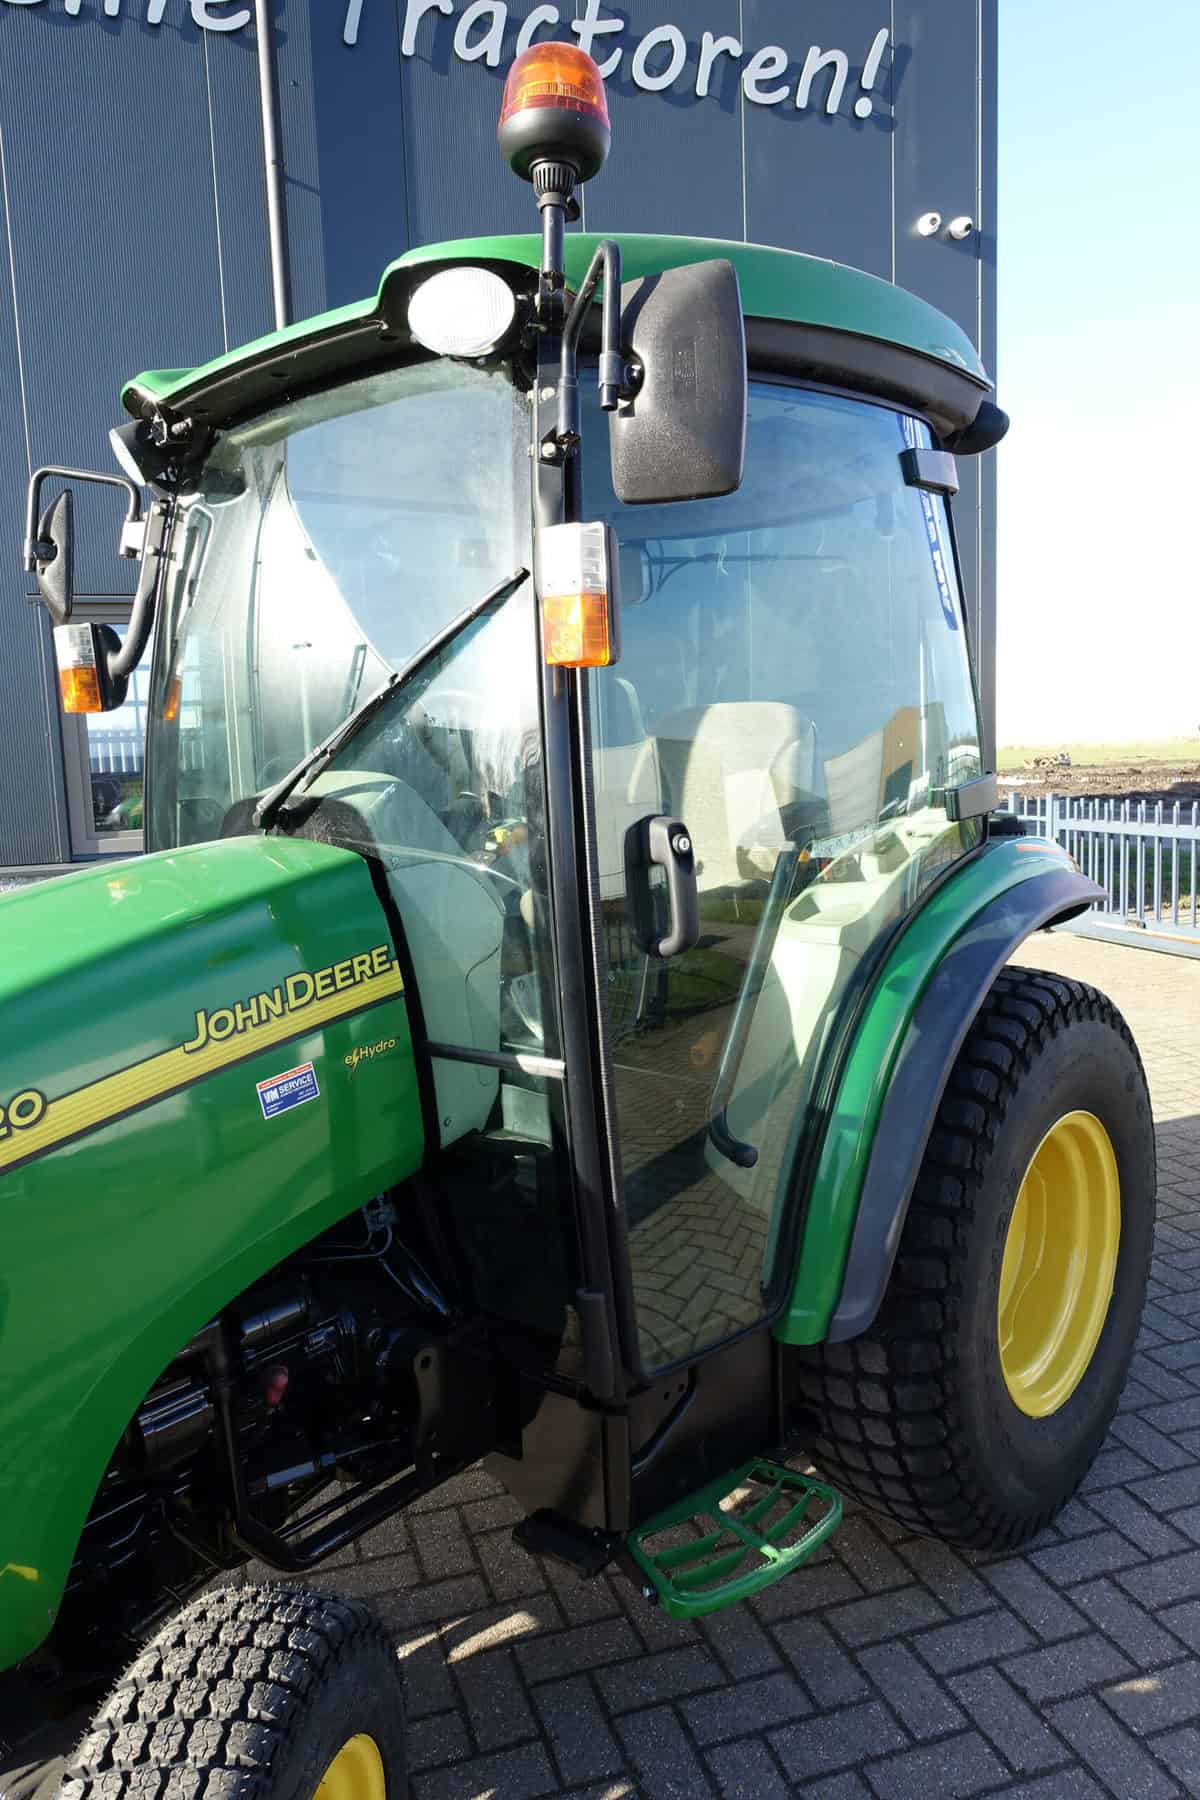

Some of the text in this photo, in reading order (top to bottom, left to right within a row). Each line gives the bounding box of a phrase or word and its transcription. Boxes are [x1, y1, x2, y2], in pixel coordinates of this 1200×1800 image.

[184, 945, 392, 1051] JOHN DEERE
[278, 1073, 313, 1094] SERVICE
